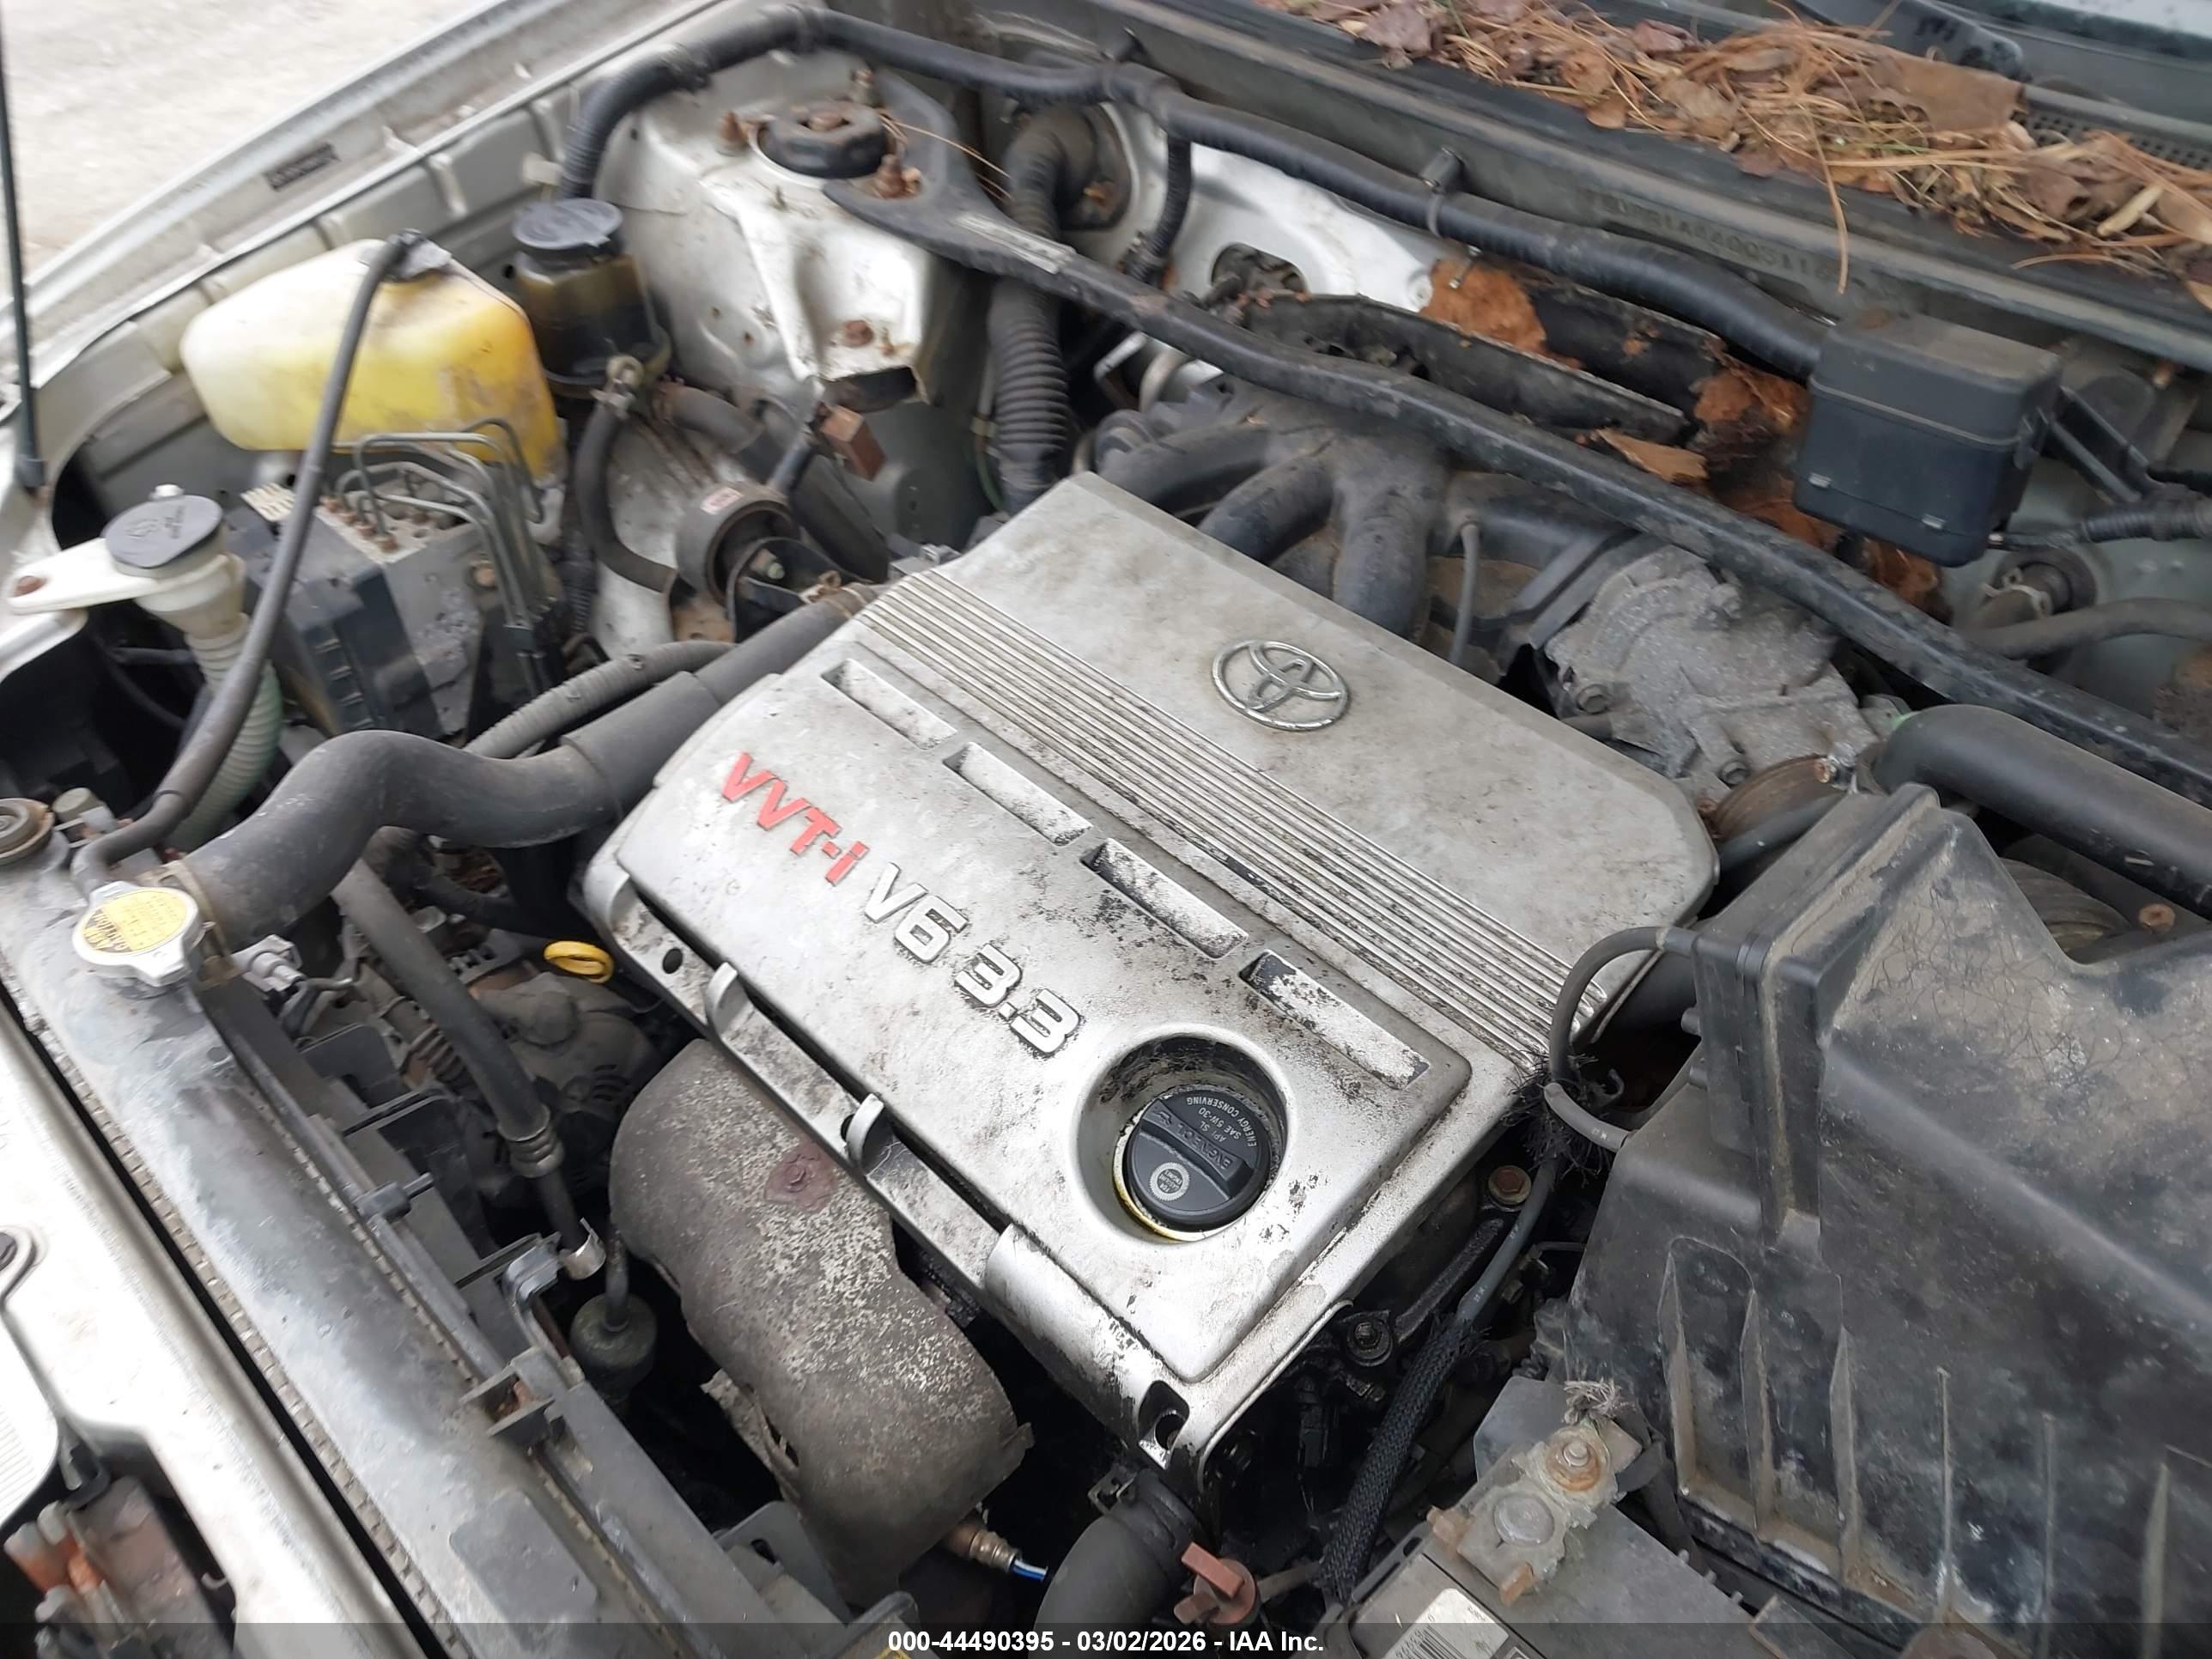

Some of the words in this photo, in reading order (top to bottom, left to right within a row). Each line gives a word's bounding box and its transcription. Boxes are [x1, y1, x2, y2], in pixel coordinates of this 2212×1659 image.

[864, 861, 969, 963] V6
[953, 943, 1082, 1056] 3.3
[1187, 1096, 1240, 1117] CONSERVING
[1198, 1107, 1225, 1128] 5W-30
[1199, 1121, 1211, 1132] SL
[1211, 1130, 1227, 1143] API
[1224, 1127, 1243, 1140] SAE
[1238, 1115, 1258, 1148] ENERGY
